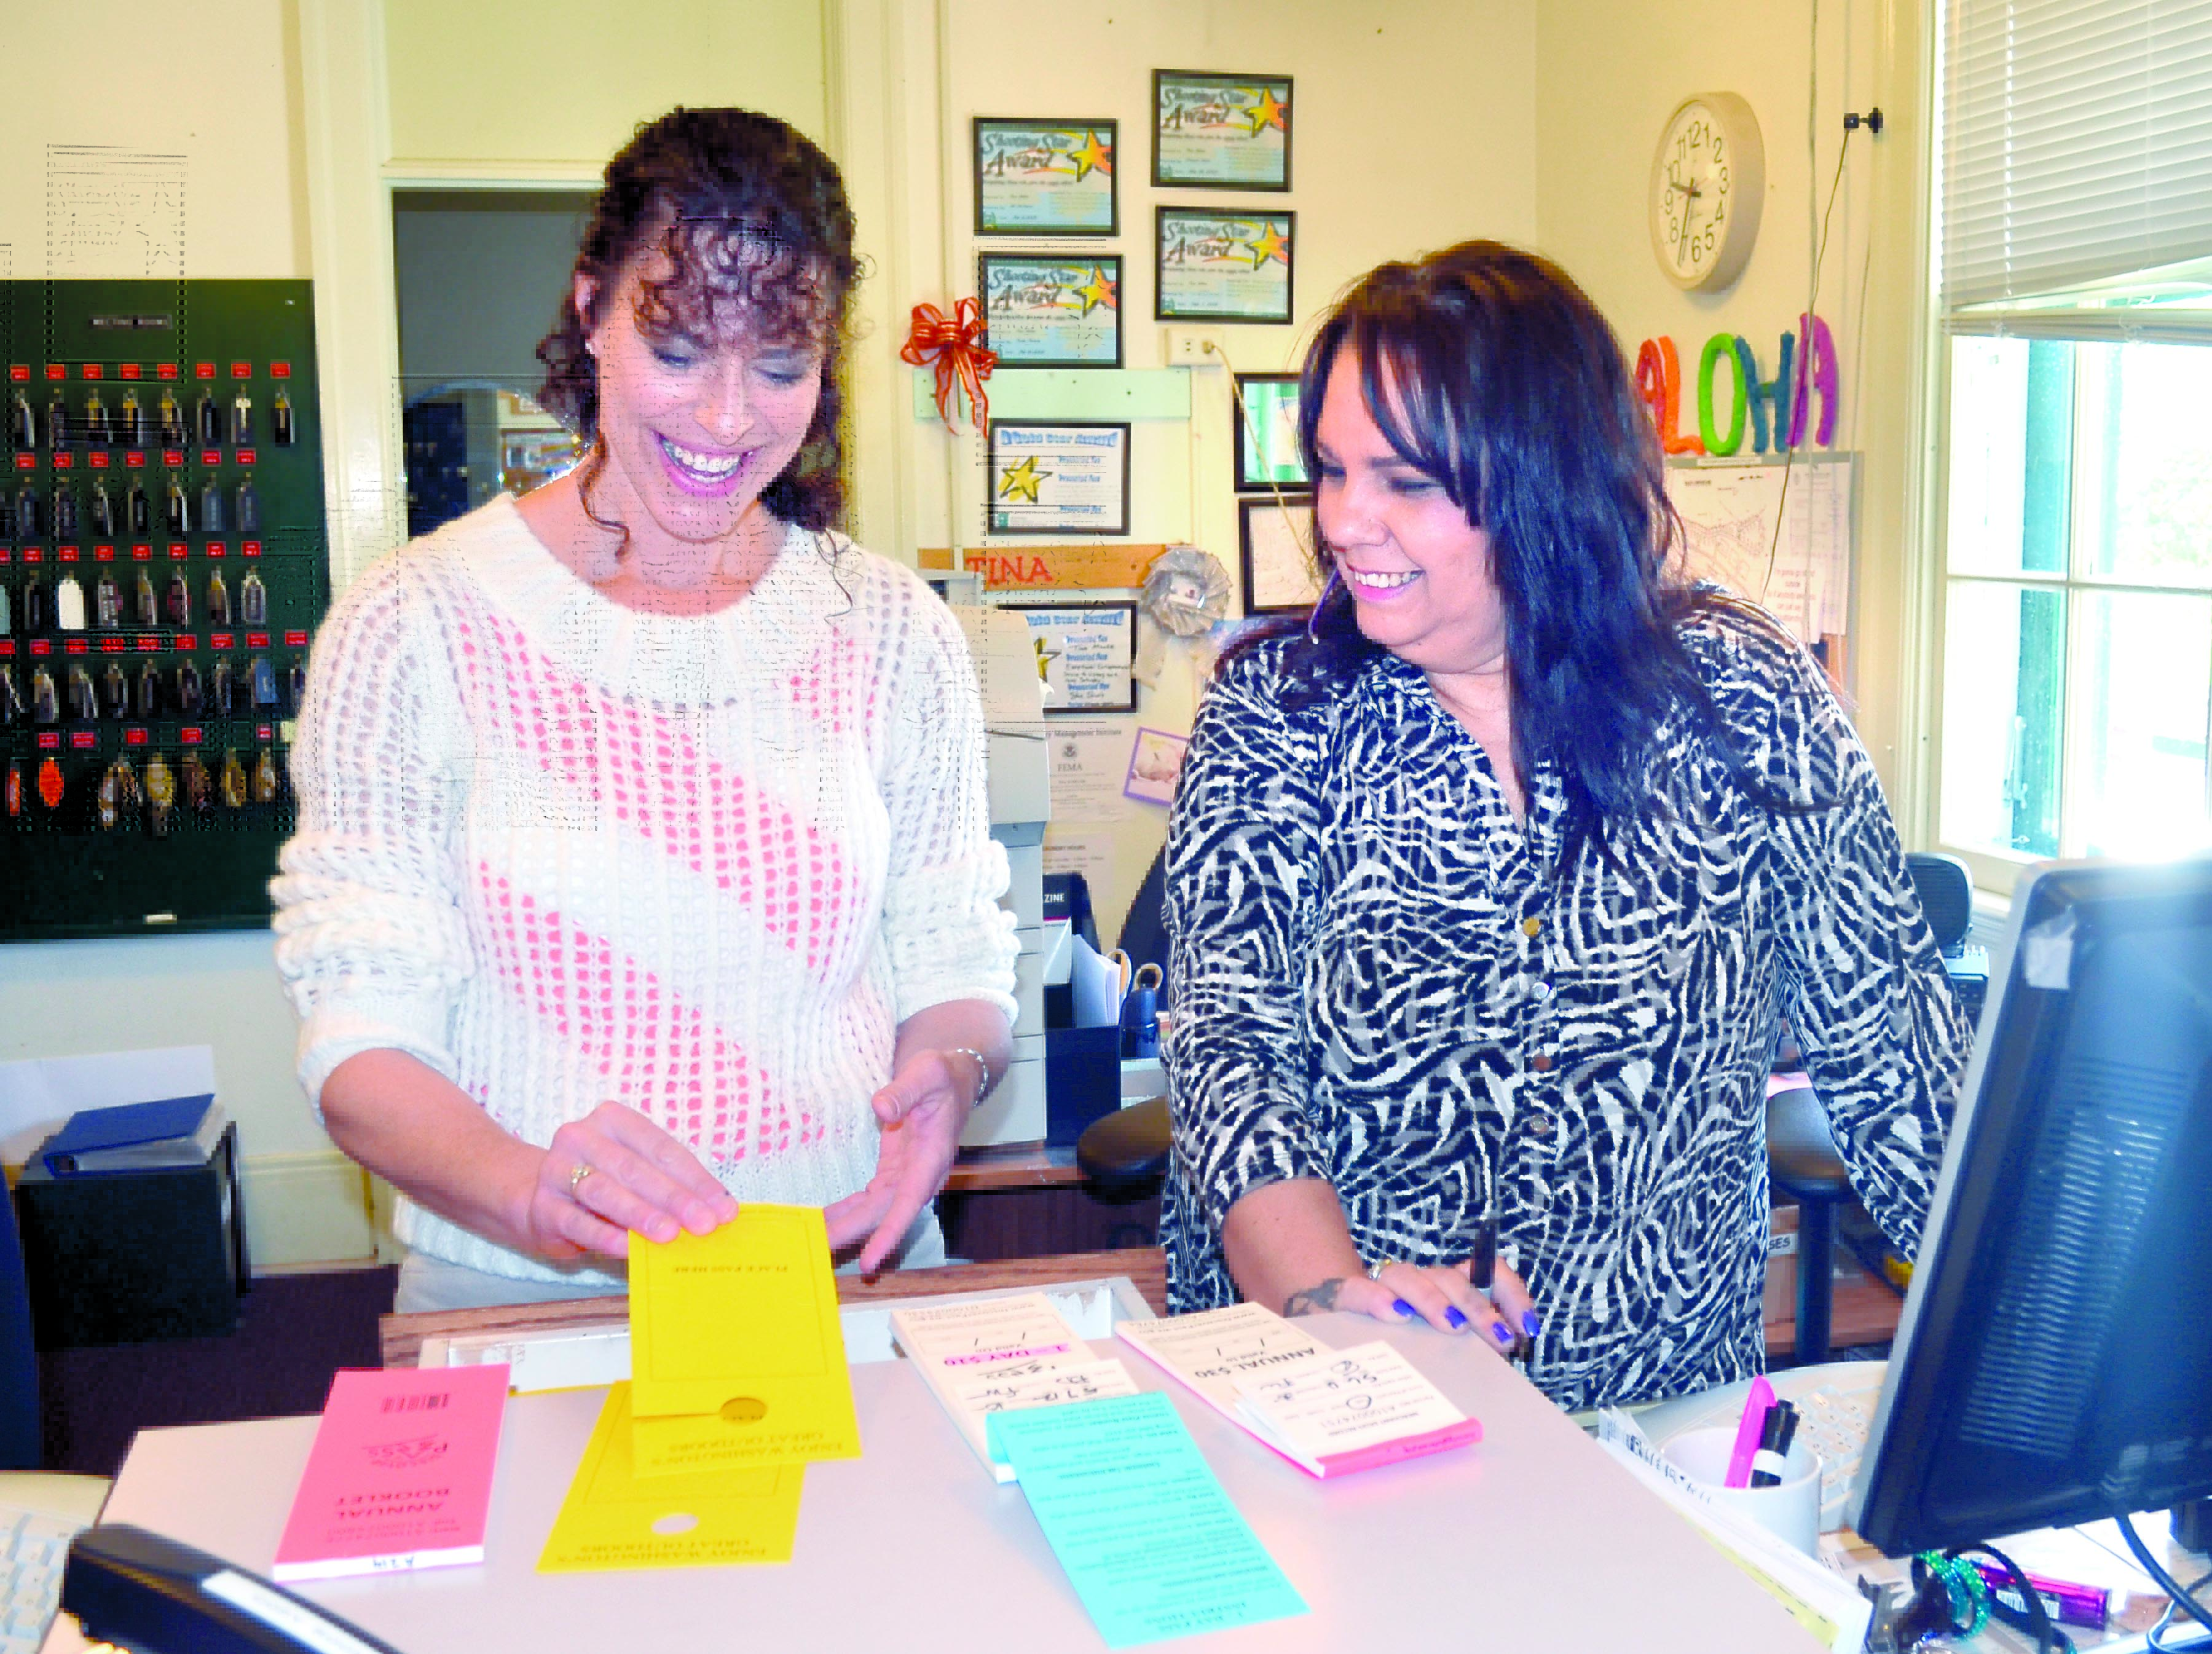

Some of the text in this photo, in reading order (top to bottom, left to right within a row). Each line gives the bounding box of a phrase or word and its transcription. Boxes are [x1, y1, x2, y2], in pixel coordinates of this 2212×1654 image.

[1219, 88, 1248, 108] Star
[1161, 102, 1231, 130] Award
[983, 133, 1073, 154] Shooting Star
[1687, 120, 1701, 148] 12
[1703, 123, 1709, 148] 1
[1677, 134, 1687, 160] 11
[1713, 136, 1723, 163] 2
[984, 149, 1055, 177] Award
[1667, 160, 1681, 186] 10
[1719, 167, 1730, 195] 3
[1664, 189, 1674, 215] 9
[1715, 200, 1724, 222] 4
[1165, 222, 1250, 241] Shooting Star
[1669, 216, 1679, 243] 8
[1705, 223, 1715, 251] 5
[1163, 236, 1234, 265] Award
[1691, 235, 1702, 262] 6
[988, 267, 1077, 290] Shooting Star
[990, 285, 1062, 310] Award
[1636, 312, 1839, 457] ALOHA
[966, 554, 1053, 586] TINA
[1057, 763, 1083, 772] FEMA
[746, 1264, 789, 1274] PLACE
[943, 1356, 982, 1366] $10
[990, 1349, 1030, 1362] DAY
[1194, 1347, 1316, 1380] ANNUAL $30
[668, 1430, 824, 1452] GREAT OUTDOORS
[789, 1442, 843, 1455] ENJOY
[334, 1489, 450, 1506] BOOKLET
[335, 1503, 444, 1519] ANNUAL
[578, 1539, 751, 1554] GREAT OUTDOORS
[709, 1548, 766, 1560] ENJOY
